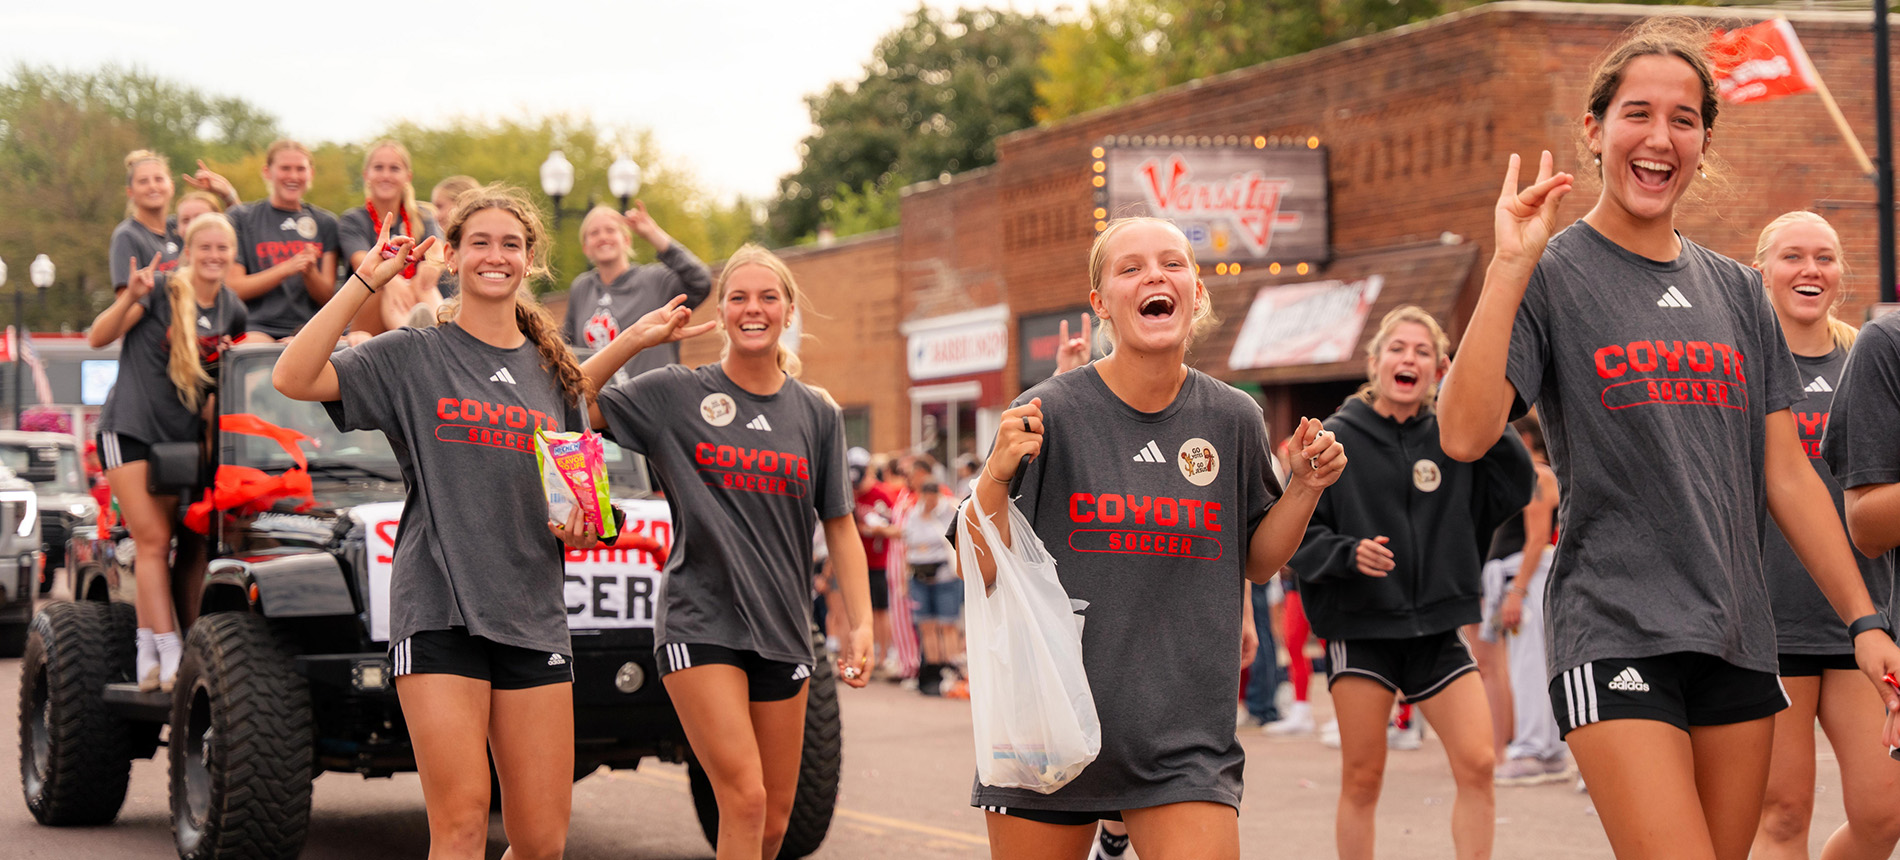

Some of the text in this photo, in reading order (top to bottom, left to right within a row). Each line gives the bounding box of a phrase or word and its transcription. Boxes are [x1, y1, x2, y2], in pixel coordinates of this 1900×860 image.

[1139, 159, 1300, 250] Varsity
[1594, 340, 1747, 384] COYOTE
[1647, 381, 1729, 404] SOCCER
[557, 456, 584, 466] FLAVOR
[571, 462, 585, 470] LIFE
[695, 442, 809, 480] COYOTE
[723, 473, 787, 493] SOCCER
[1069, 492, 1221, 532] COYOTE
[1109, 533, 1192, 554] SOCCER
[565, 575, 653, 619] CER
[1608, 681, 1650, 692] adidas
